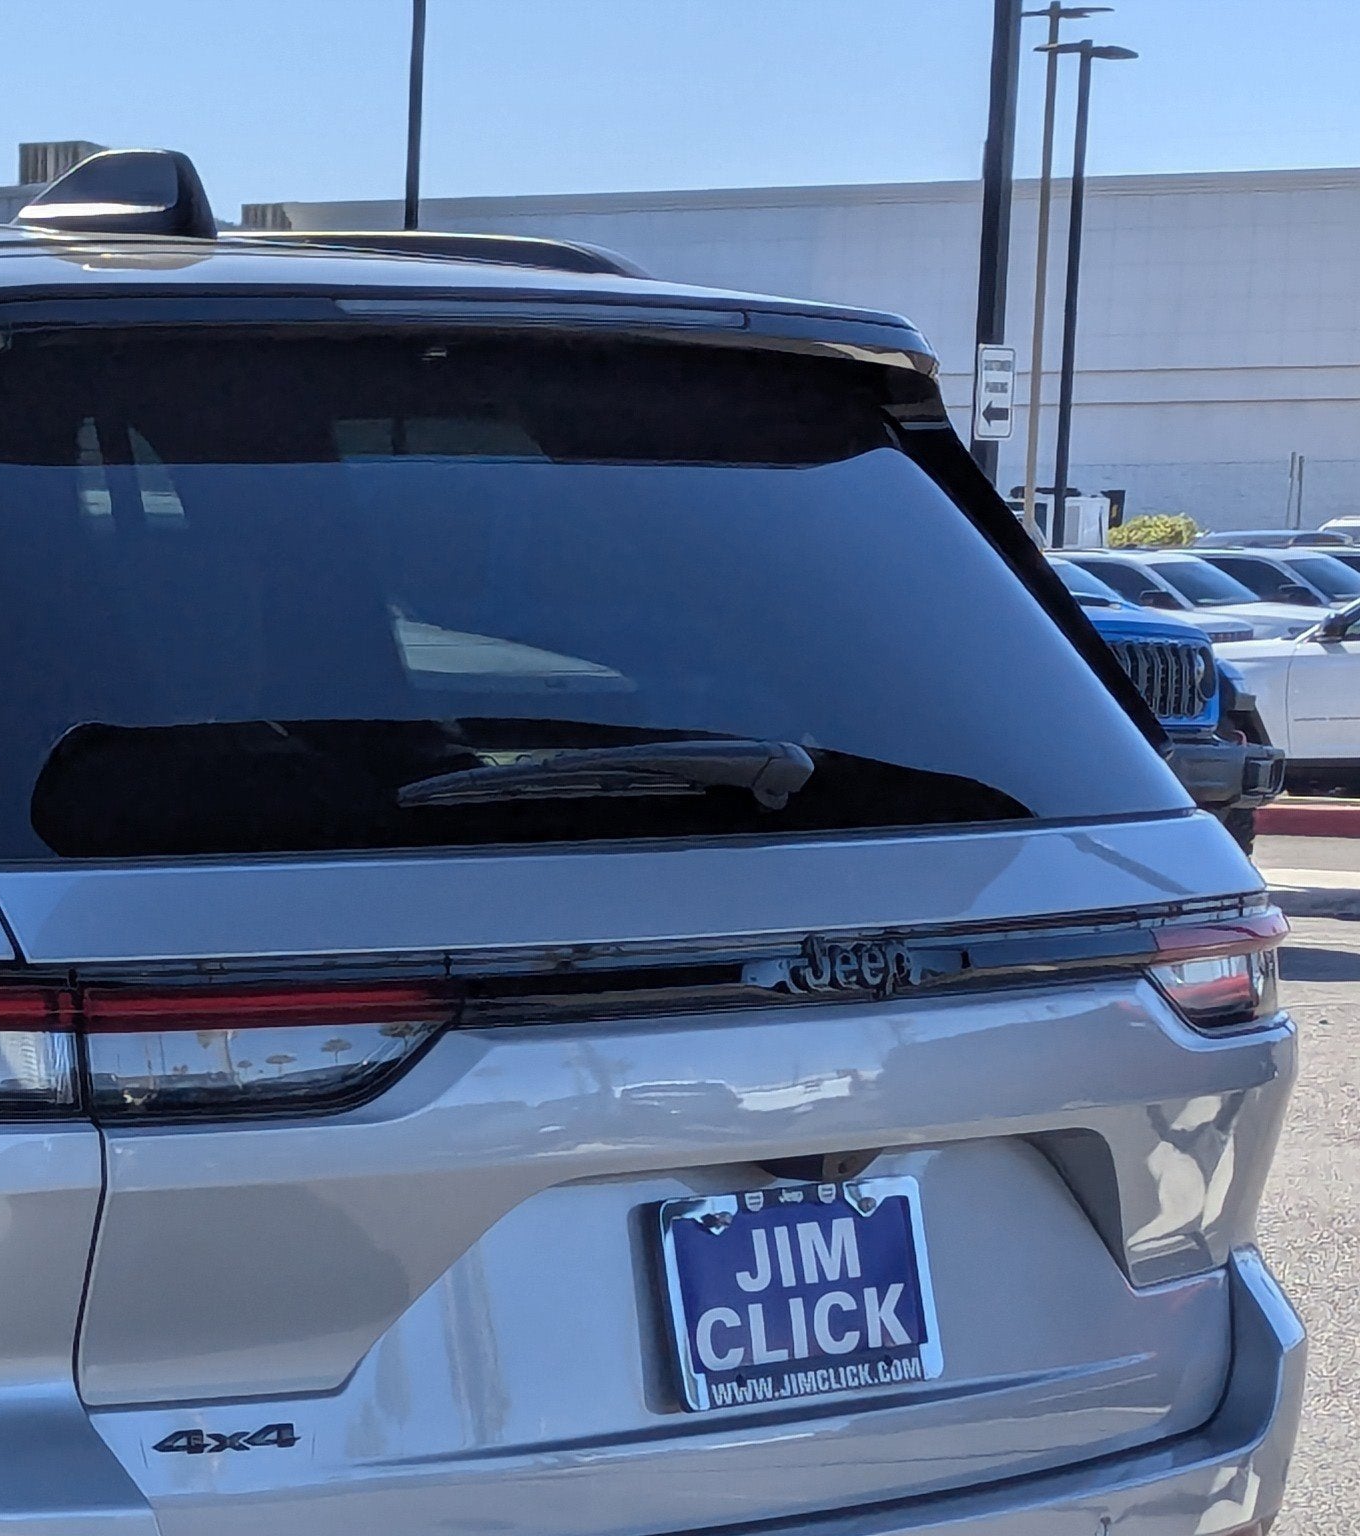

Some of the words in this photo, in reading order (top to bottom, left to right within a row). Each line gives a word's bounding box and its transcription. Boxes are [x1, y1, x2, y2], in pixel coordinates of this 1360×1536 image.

[801, 934, 921, 998] Jeep
[736, 1218, 861, 1292] JIM
[696, 1283, 912, 1371] CLICK
[712, 1357, 923, 1406] WWW.JIMCLICK.COM
[153, 1423, 302, 1455] 4x4
